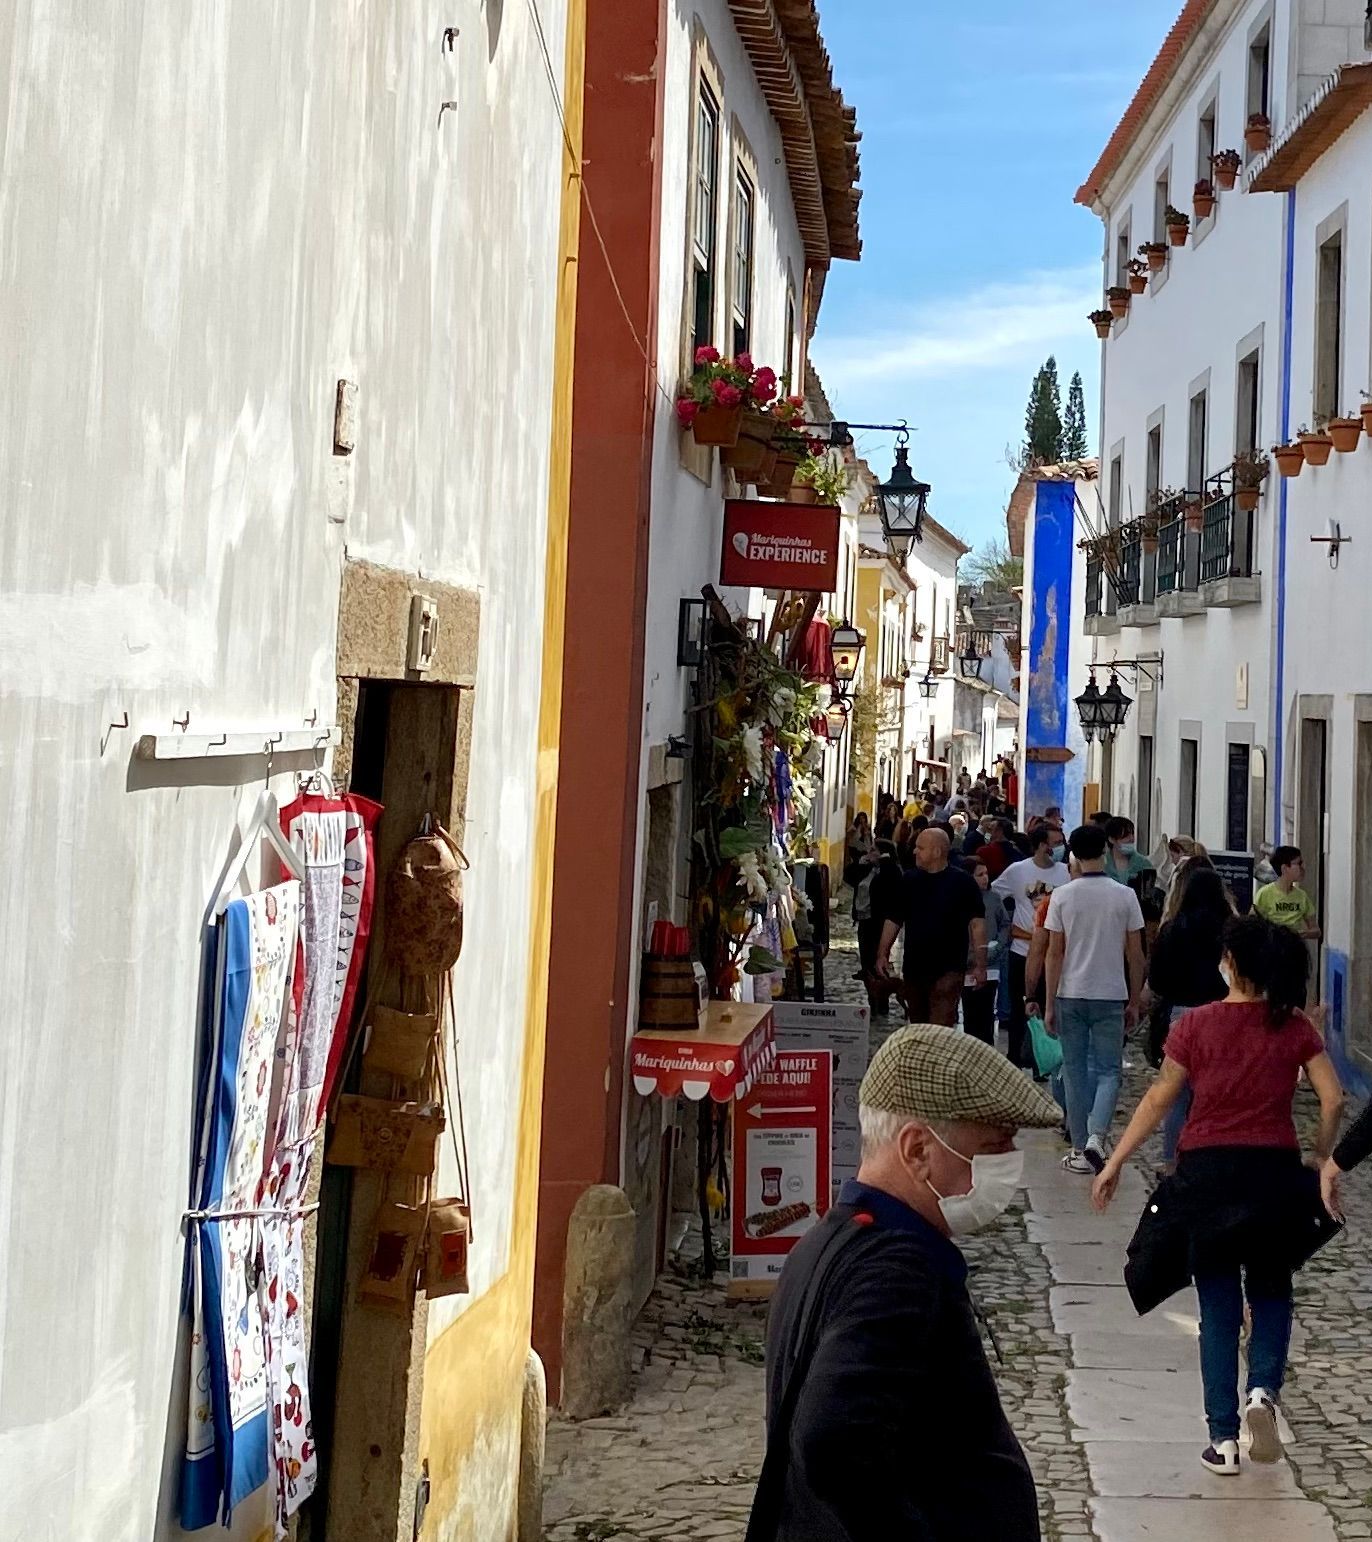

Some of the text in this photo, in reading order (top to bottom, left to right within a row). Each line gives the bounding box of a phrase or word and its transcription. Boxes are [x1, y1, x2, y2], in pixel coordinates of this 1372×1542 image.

[750, 533, 812, 548] Mariquinhas
[749, 545, 828, 565] EXPERIENCE
[634, 1053, 714, 1073] Mariquinhas
[779, 1058, 818, 1071] WAFFLE
